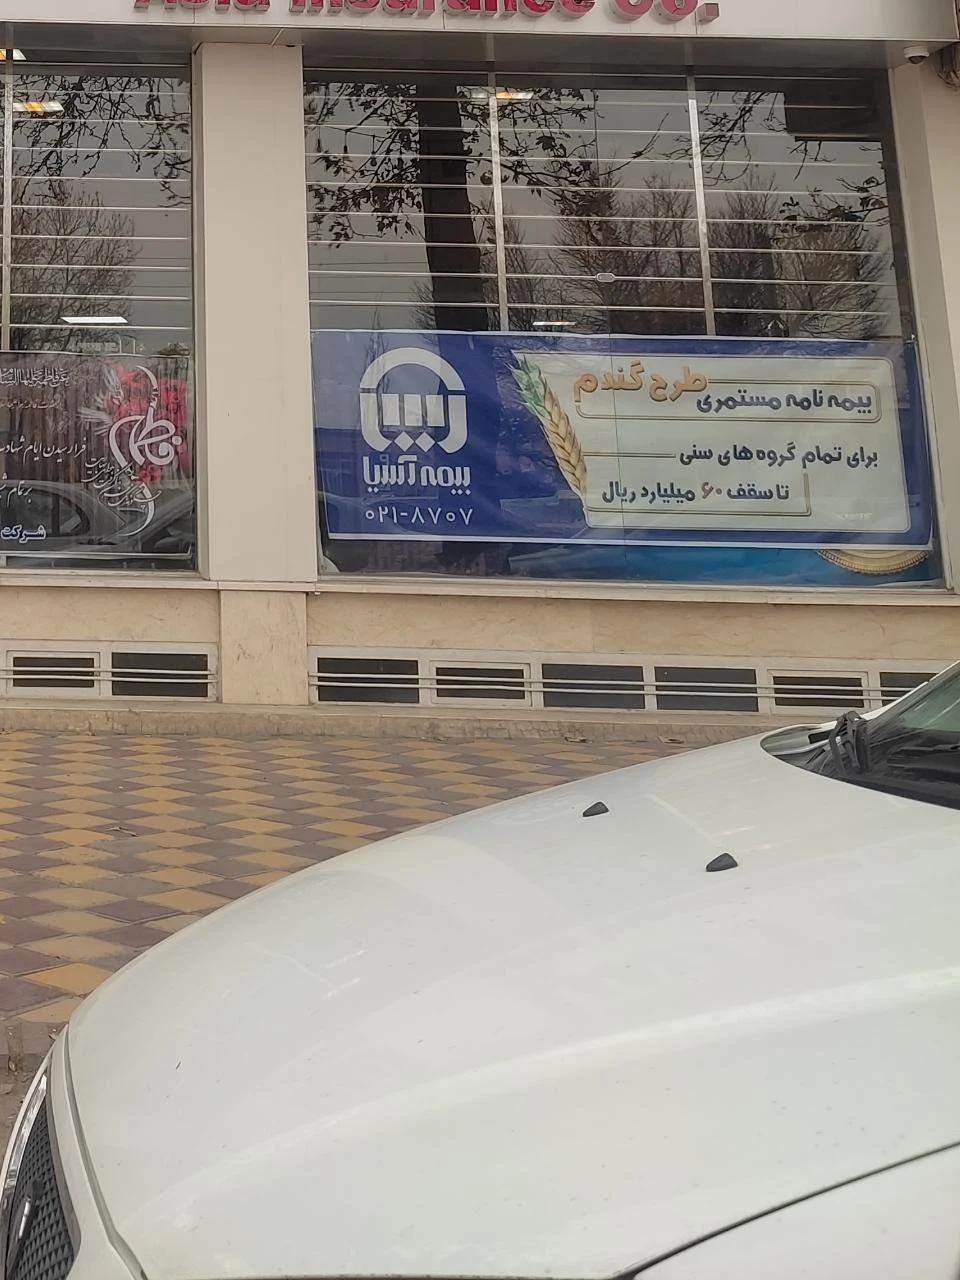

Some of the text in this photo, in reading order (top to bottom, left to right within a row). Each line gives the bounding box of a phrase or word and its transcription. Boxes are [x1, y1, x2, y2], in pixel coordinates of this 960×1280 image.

[574, 360, 709, 403] طرح گندم
[696, 388, 873, 415] بیمه نامه مستمری
[22, 442, 43, 465] ایام
[679, 443, 714, 465] سنی
[801, 445, 843, 469] تمام
[846, 446, 878, 468] برای
[362, 454, 472, 496] بیمه آسیا
[6, 480, 25, 506] تمام
[23, 484, 33, 503] بر
[601, 481, 790, 505] تا سقف ۶۰ میلیارد ریال
[365, 505, 473, 526] ۰۲۱-۸۷۰۷
[1, 523, 46, 544] شرکت
